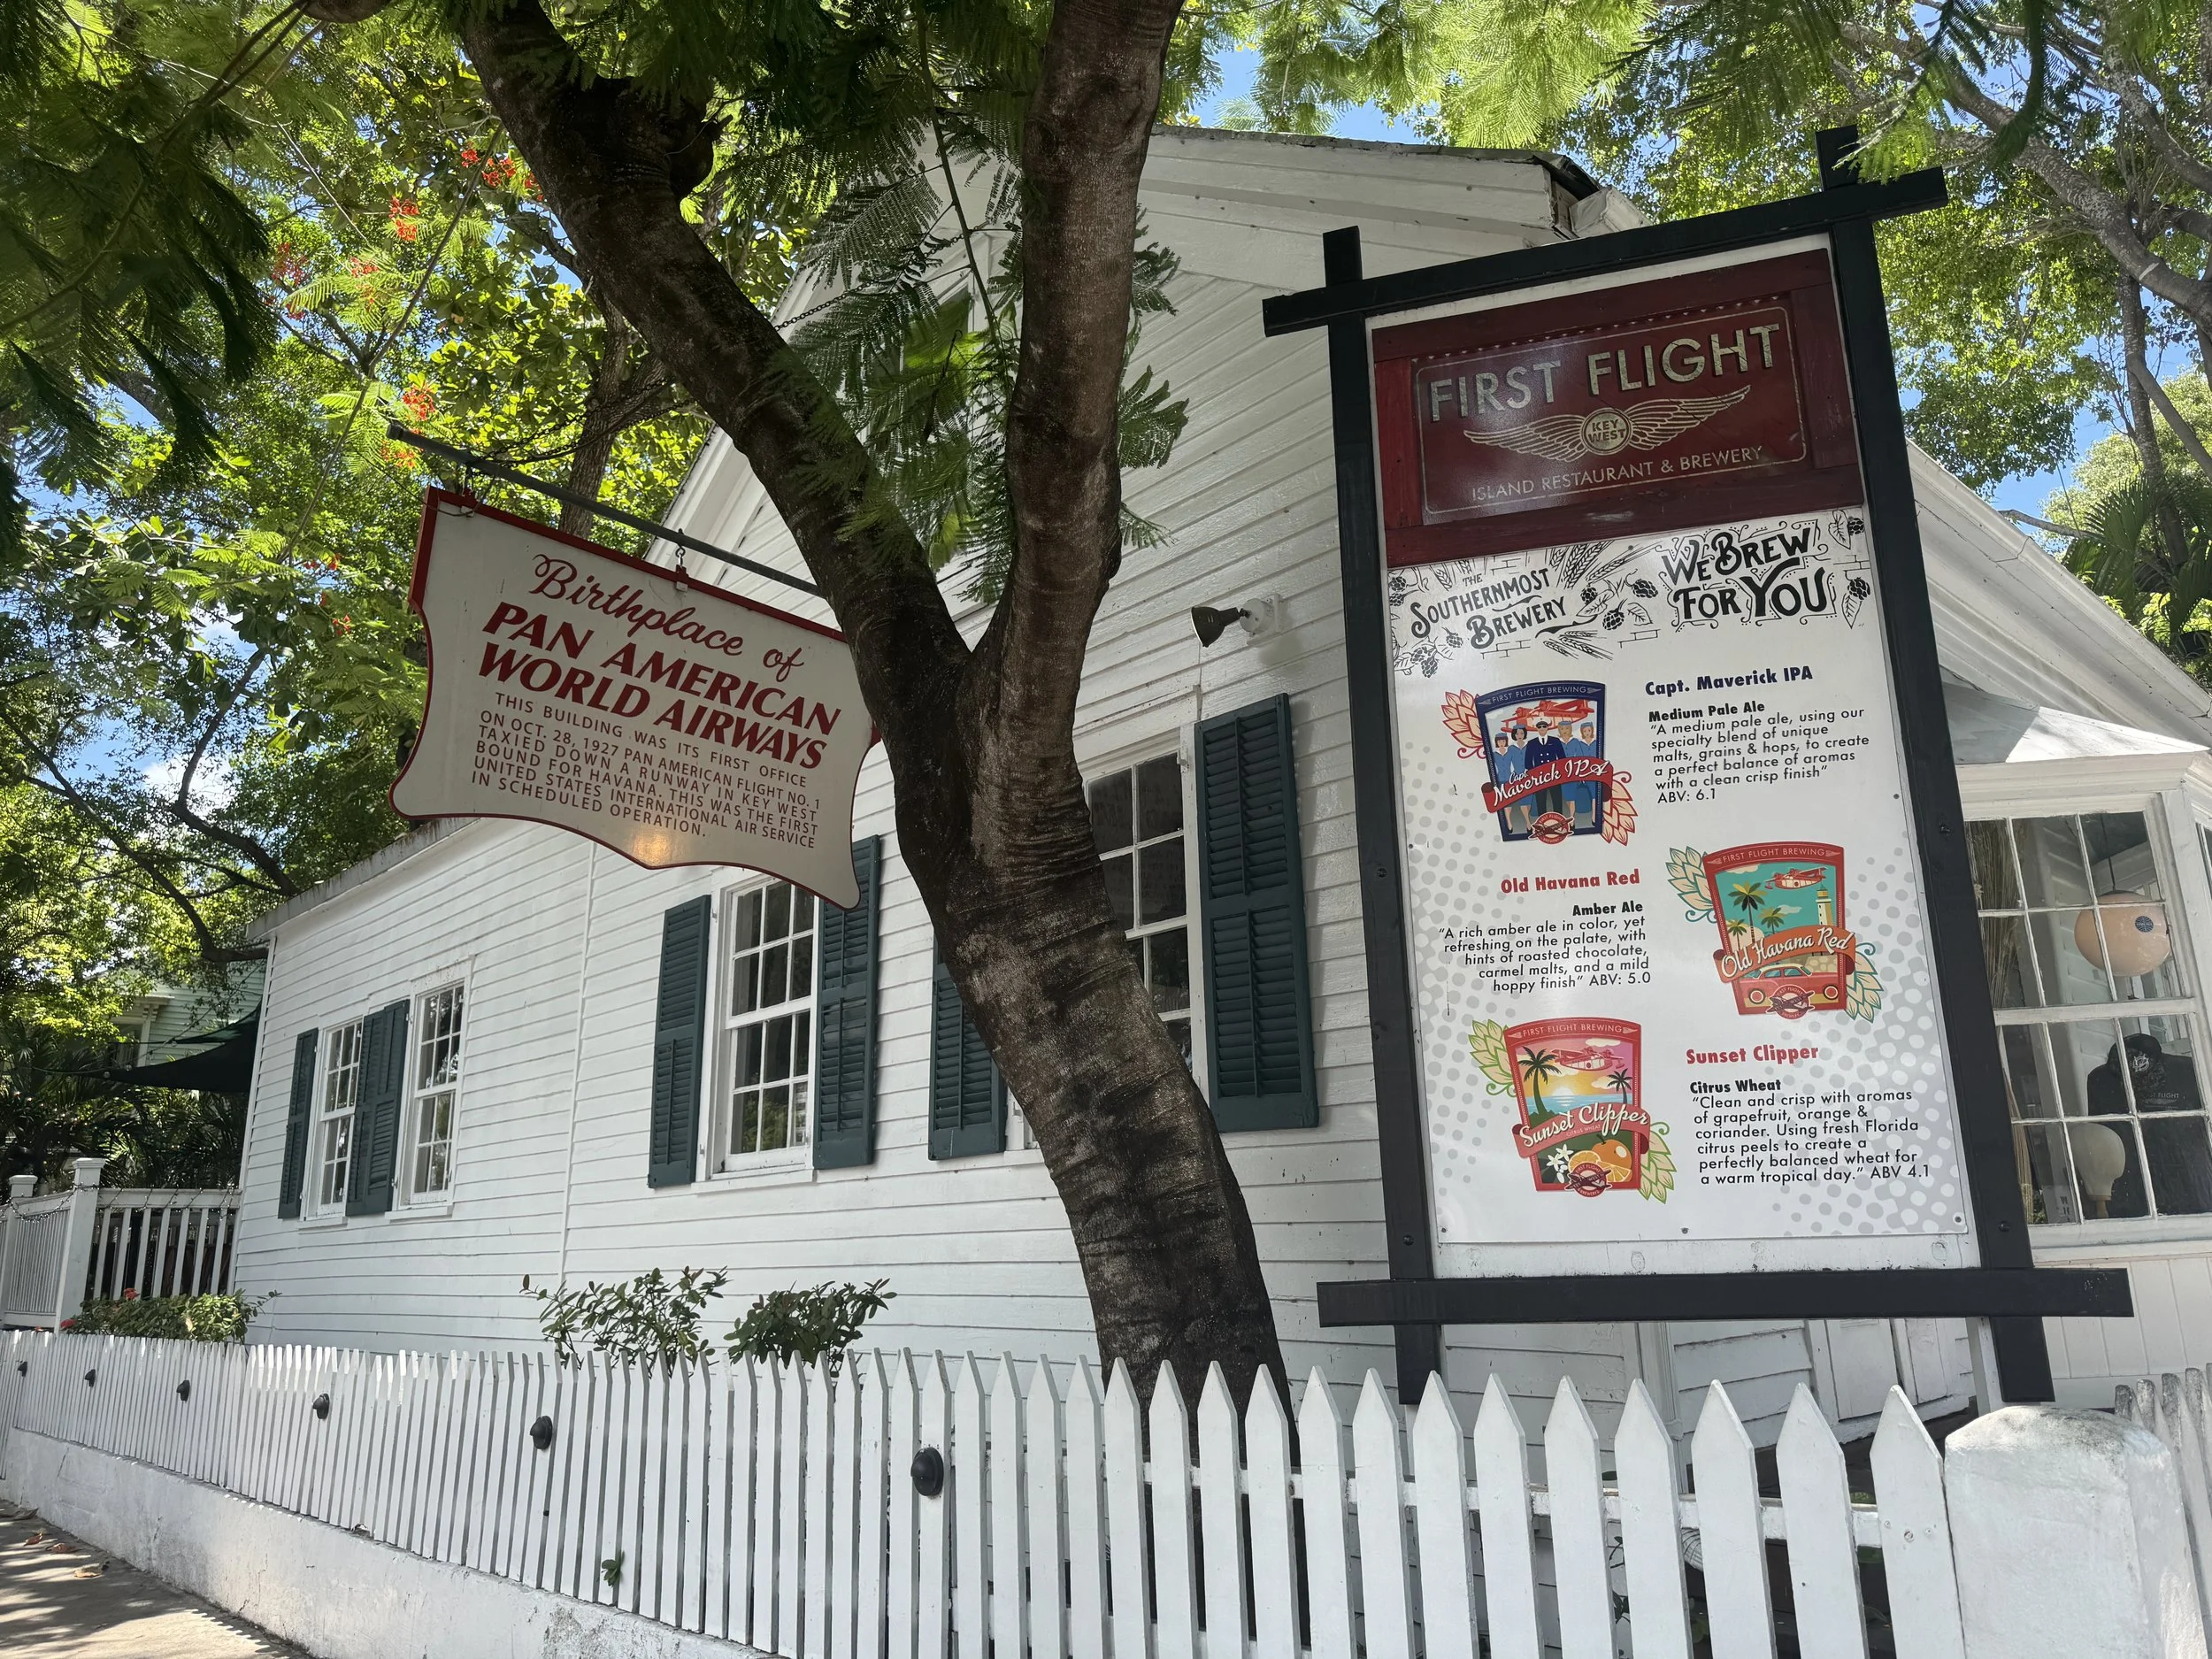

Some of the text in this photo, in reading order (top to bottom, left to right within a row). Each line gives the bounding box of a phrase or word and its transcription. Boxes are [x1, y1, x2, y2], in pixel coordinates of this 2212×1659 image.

[1429, 323, 1779, 422] FIRST FLIGHT
[1588, 429, 1625, 442] WEST
[1592, 419, 1618, 432] KEY
[1472, 445, 1762, 502] ISLAND RESTAURANT & BREWERY
[1463, 573, 1483, 587] THE
[1410, 568, 1550, 639] SOUTHERNMOST
[531, 554, 804, 681] Birthplace of
[1466, 596, 1566, 649] BREWERY
[482, 602, 841, 735] PAN AMERICAN
[1645, 665, 1813, 697] Capt. Maverick IPA
[479, 642, 826, 769] WORLD AIRWAYS
[1492, 686, 1586, 703] FIRST FLIGHT BREWING
[1648, 700, 1764, 722] Medium Pale Ale
[1671, 718, 1724, 733] medium
[1731, 715, 1762, 732] pale
[1767, 713, 1793, 725] ale,
[1799, 710, 1835, 723] using
[1840, 709, 1864, 718] our
[495, 691, 806, 787] THIS BUILDING WAS ITS FIRST OFFICE
[1651, 726, 1828, 752] specialty blend of unique
[1653, 734, 1869, 763] malts, grains & hops, to create
[478, 724, 818, 821] TAXIED DOWN A RUNWAY IN KEY WEST
[480, 710, 819, 810] ON OCT. 28, 1927 PAN AMERICAN FLIGHT NO. 1
[1667, 760, 1718, 780] perfect
[1723, 757, 1778, 770] balance
[1784, 753, 1798, 765] of
[1803, 752, 1855, 764] aromas
[476, 740, 818, 835] BOUND FOR HAVANA. THIS WAS THE FIRST
[1493, 758, 1610, 807] Maverick IPA
[1655, 776, 1683, 790] with
[1702, 773, 1740, 786] clean
[1745, 770, 1778, 784] crisp
[472, 770, 705, 837] IN SCHEDULED OPERATION.
[474, 755, 815, 849] UNITED STATES INTERNATIONAL AIR SERVICE
[1657, 787, 1715, 803] ABV: 6.1
[1722, 847, 1825, 864] FIRST FLIGHT BREWING
[1501, 868, 1640, 894] Old Havana Red
[1572, 900, 1643, 916] Amber Ale
[1444, 938, 1509, 952] refreshing
[1537, 934, 1557, 947] the
[1563, 932, 1611, 949] palate,
[1617, 929, 1646, 941] with
[1720, 927, 1855, 979] Old Havana Red
[1464, 945, 1647, 965] hints of roasted chocolate,
[1493, 979, 1535, 995] hoppy
[1588, 972, 1621, 986] ABV:
[1627, 971, 1650, 984] 5.0
[1522, 1023, 1623, 1038] FIRST FLIGHT BREWING
[1686, 1044, 1818, 1064] Sunset Clipper
[1689, 1078, 1781, 1094] Citrus Wheat
[1747, 1094, 1774, 1106] and
[1780, 1093, 1815, 1108] crisp
[1820, 1091, 1850, 1103] with
[1856, 1091, 1912, 1102] aromas
[1518, 1102, 1649, 1148] Sunset Clipper
[1565, 1124, 1601, 1137] CITRUS WHEAT
[1695, 1118, 1918, 1139] coriander. Using fresh Florida
[1699, 1150, 1917, 1173] perfectly balanced wheat for
